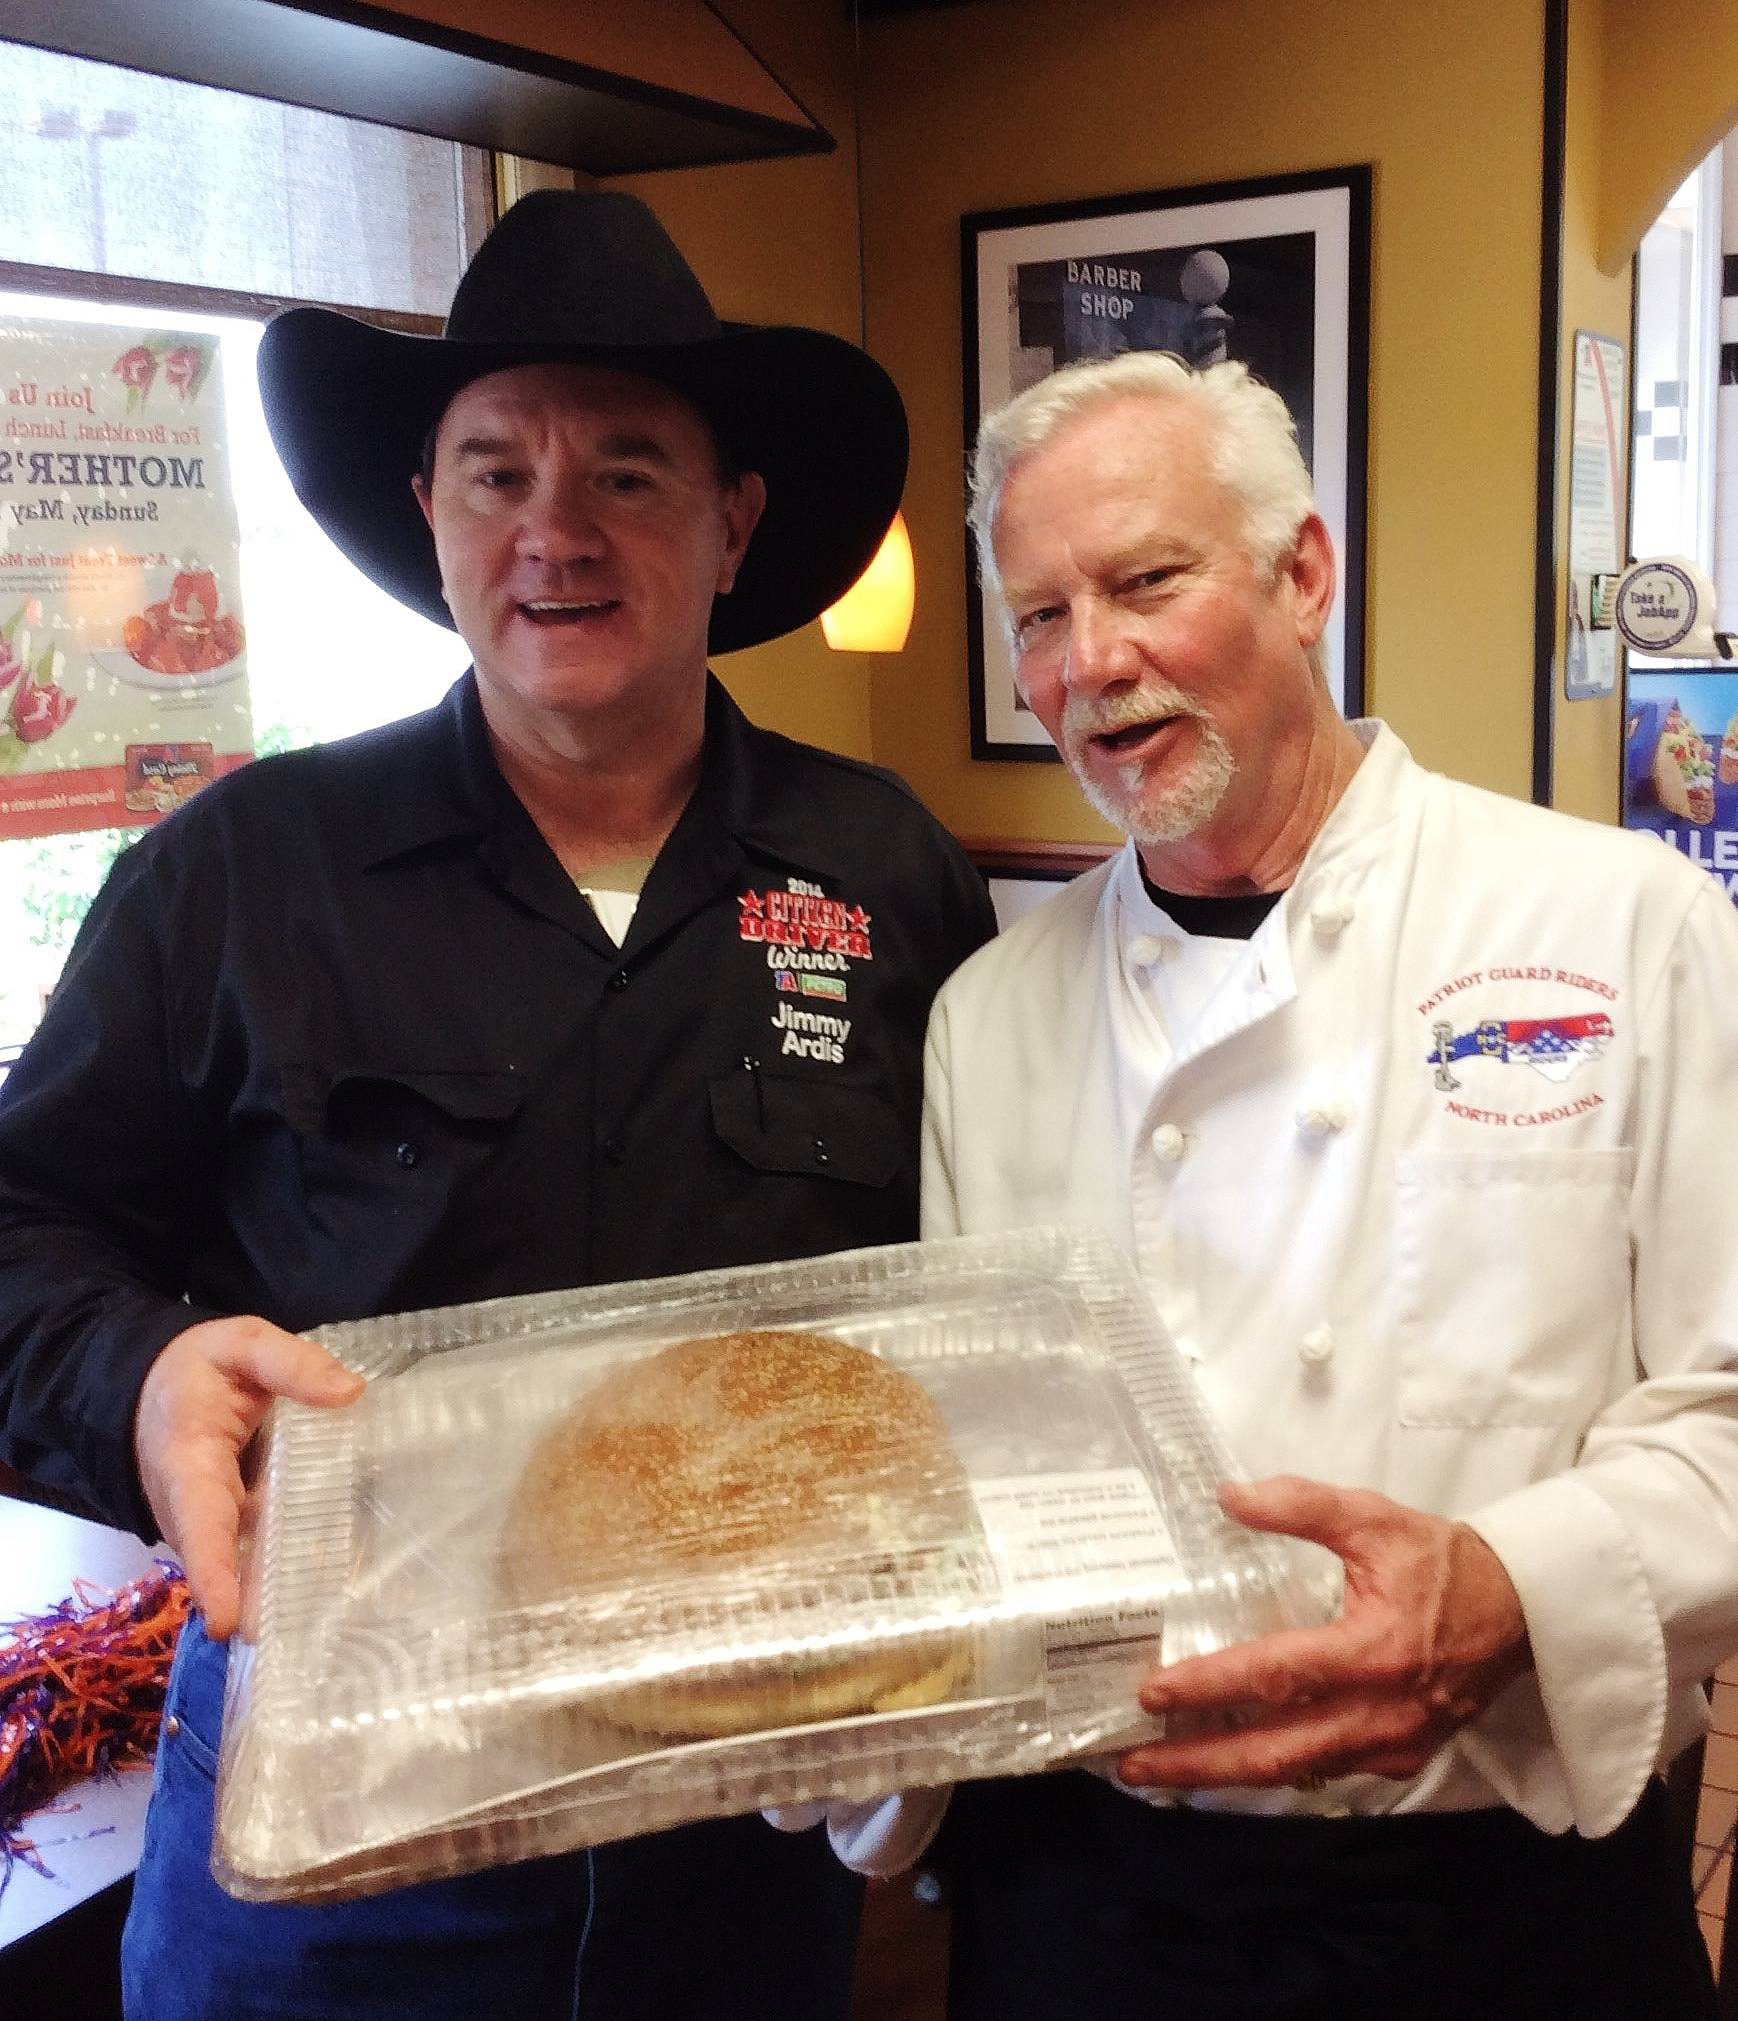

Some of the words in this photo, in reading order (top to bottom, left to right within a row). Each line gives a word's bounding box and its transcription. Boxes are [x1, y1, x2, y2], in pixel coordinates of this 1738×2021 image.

[1067, 259, 1141, 292] BARBER
[1081, 293, 1134, 320] SHOP
[787, 877, 825, 898] 2014
[765, 890, 848, 932] CITIZEN
[739, 916, 873, 960] DRIVER
[767, 945, 851, 972] Winner
[1417, 972, 1483, 1016] PATRIOT
[1488, 967, 1552, 981] GUARD
[1555, 969, 1619, 1001] RIDERS
[771, 1000, 852, 1043] Jimmy
[781, 1030, 845, 1064] Ardis
[1445, 1101, 1508, 1126] NORTH
[1513, 1092, 1605, 1127] CAROLINA
